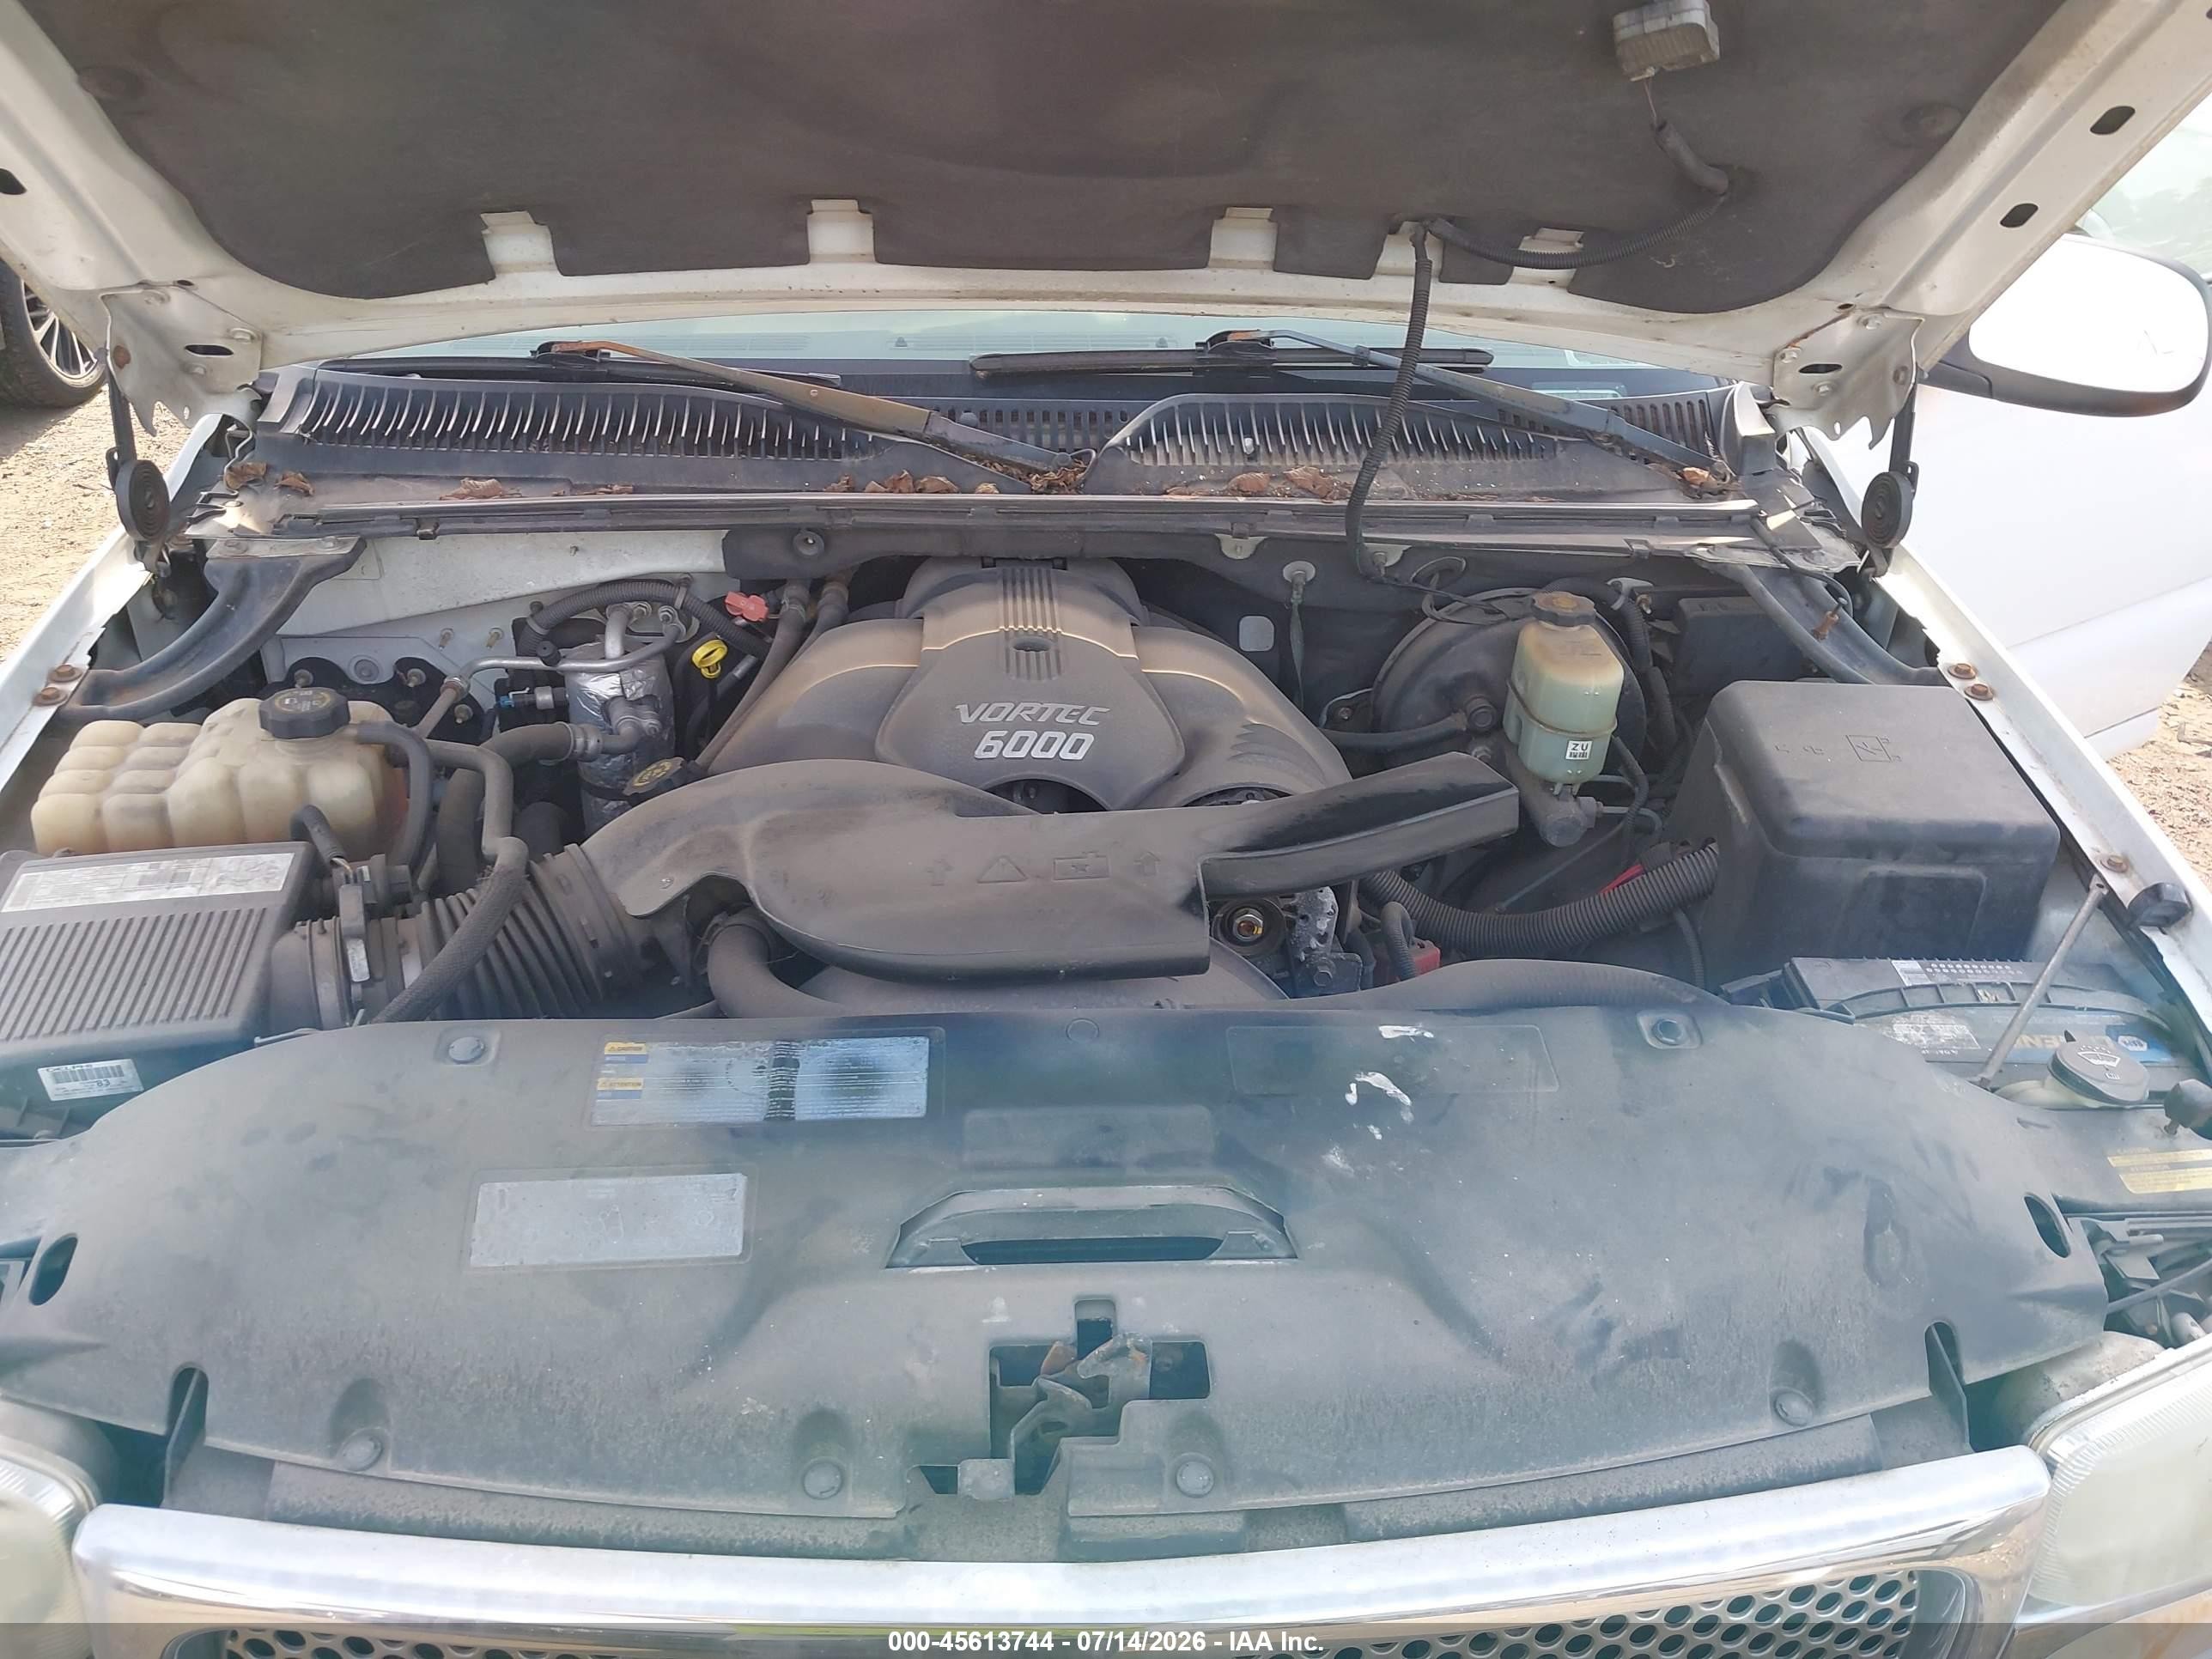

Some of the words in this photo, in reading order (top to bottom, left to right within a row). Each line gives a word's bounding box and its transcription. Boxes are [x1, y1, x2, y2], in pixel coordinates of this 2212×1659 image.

[955, 702, 1111, 726] VORTEC
[974, 730, 1095, 761] 6000
[1571, 742, 1589, 751] ZU
